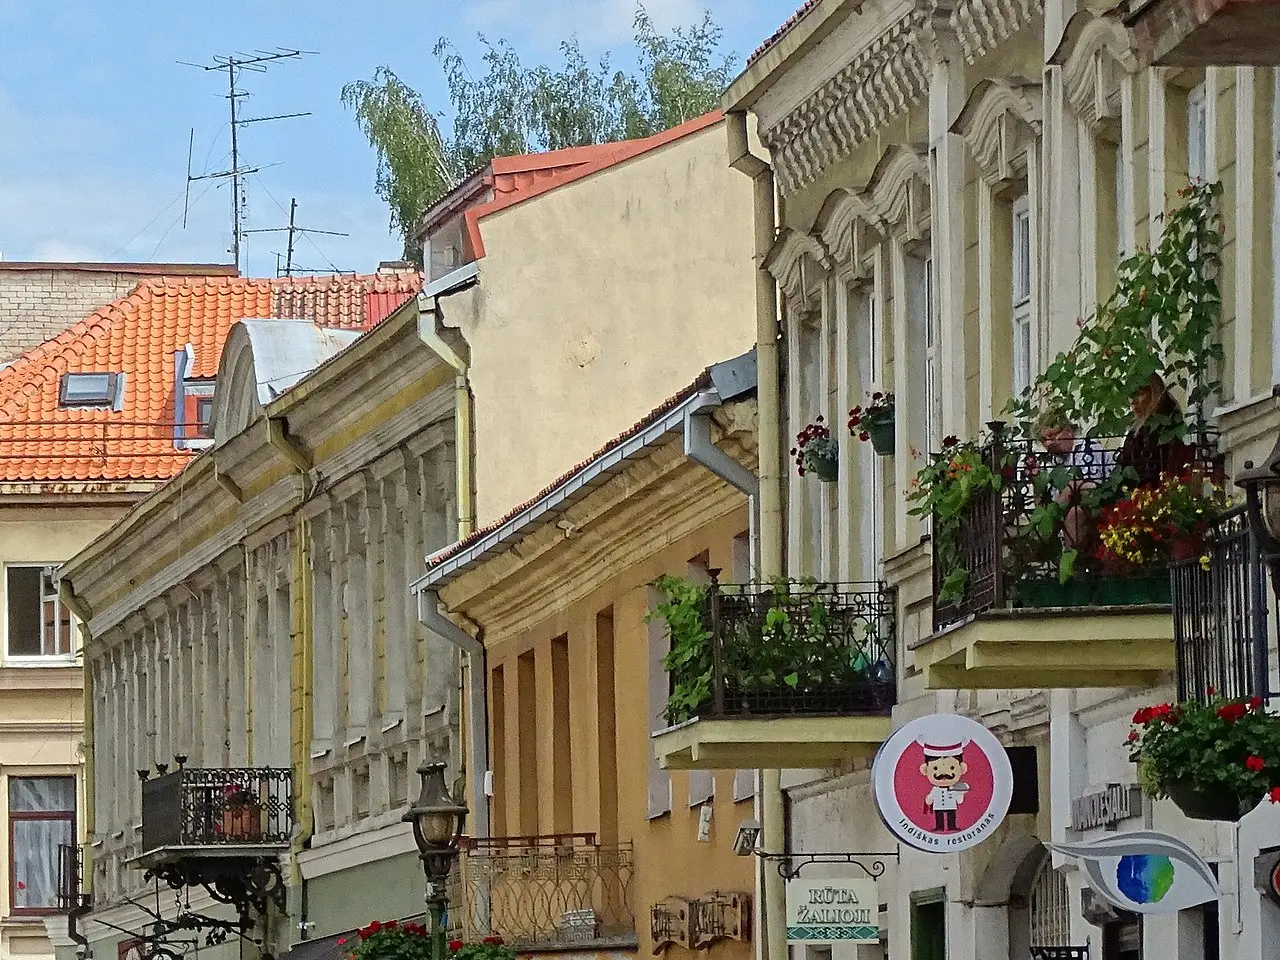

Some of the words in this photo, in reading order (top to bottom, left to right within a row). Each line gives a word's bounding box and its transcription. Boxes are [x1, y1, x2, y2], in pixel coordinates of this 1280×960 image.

[899, 818, 939, 846] Indiškas
[947, 813, 995, 846] restoranas
[809, 886, 858, 904] RŪTA
[797, 905, 870, 924] ŽALIOJI
